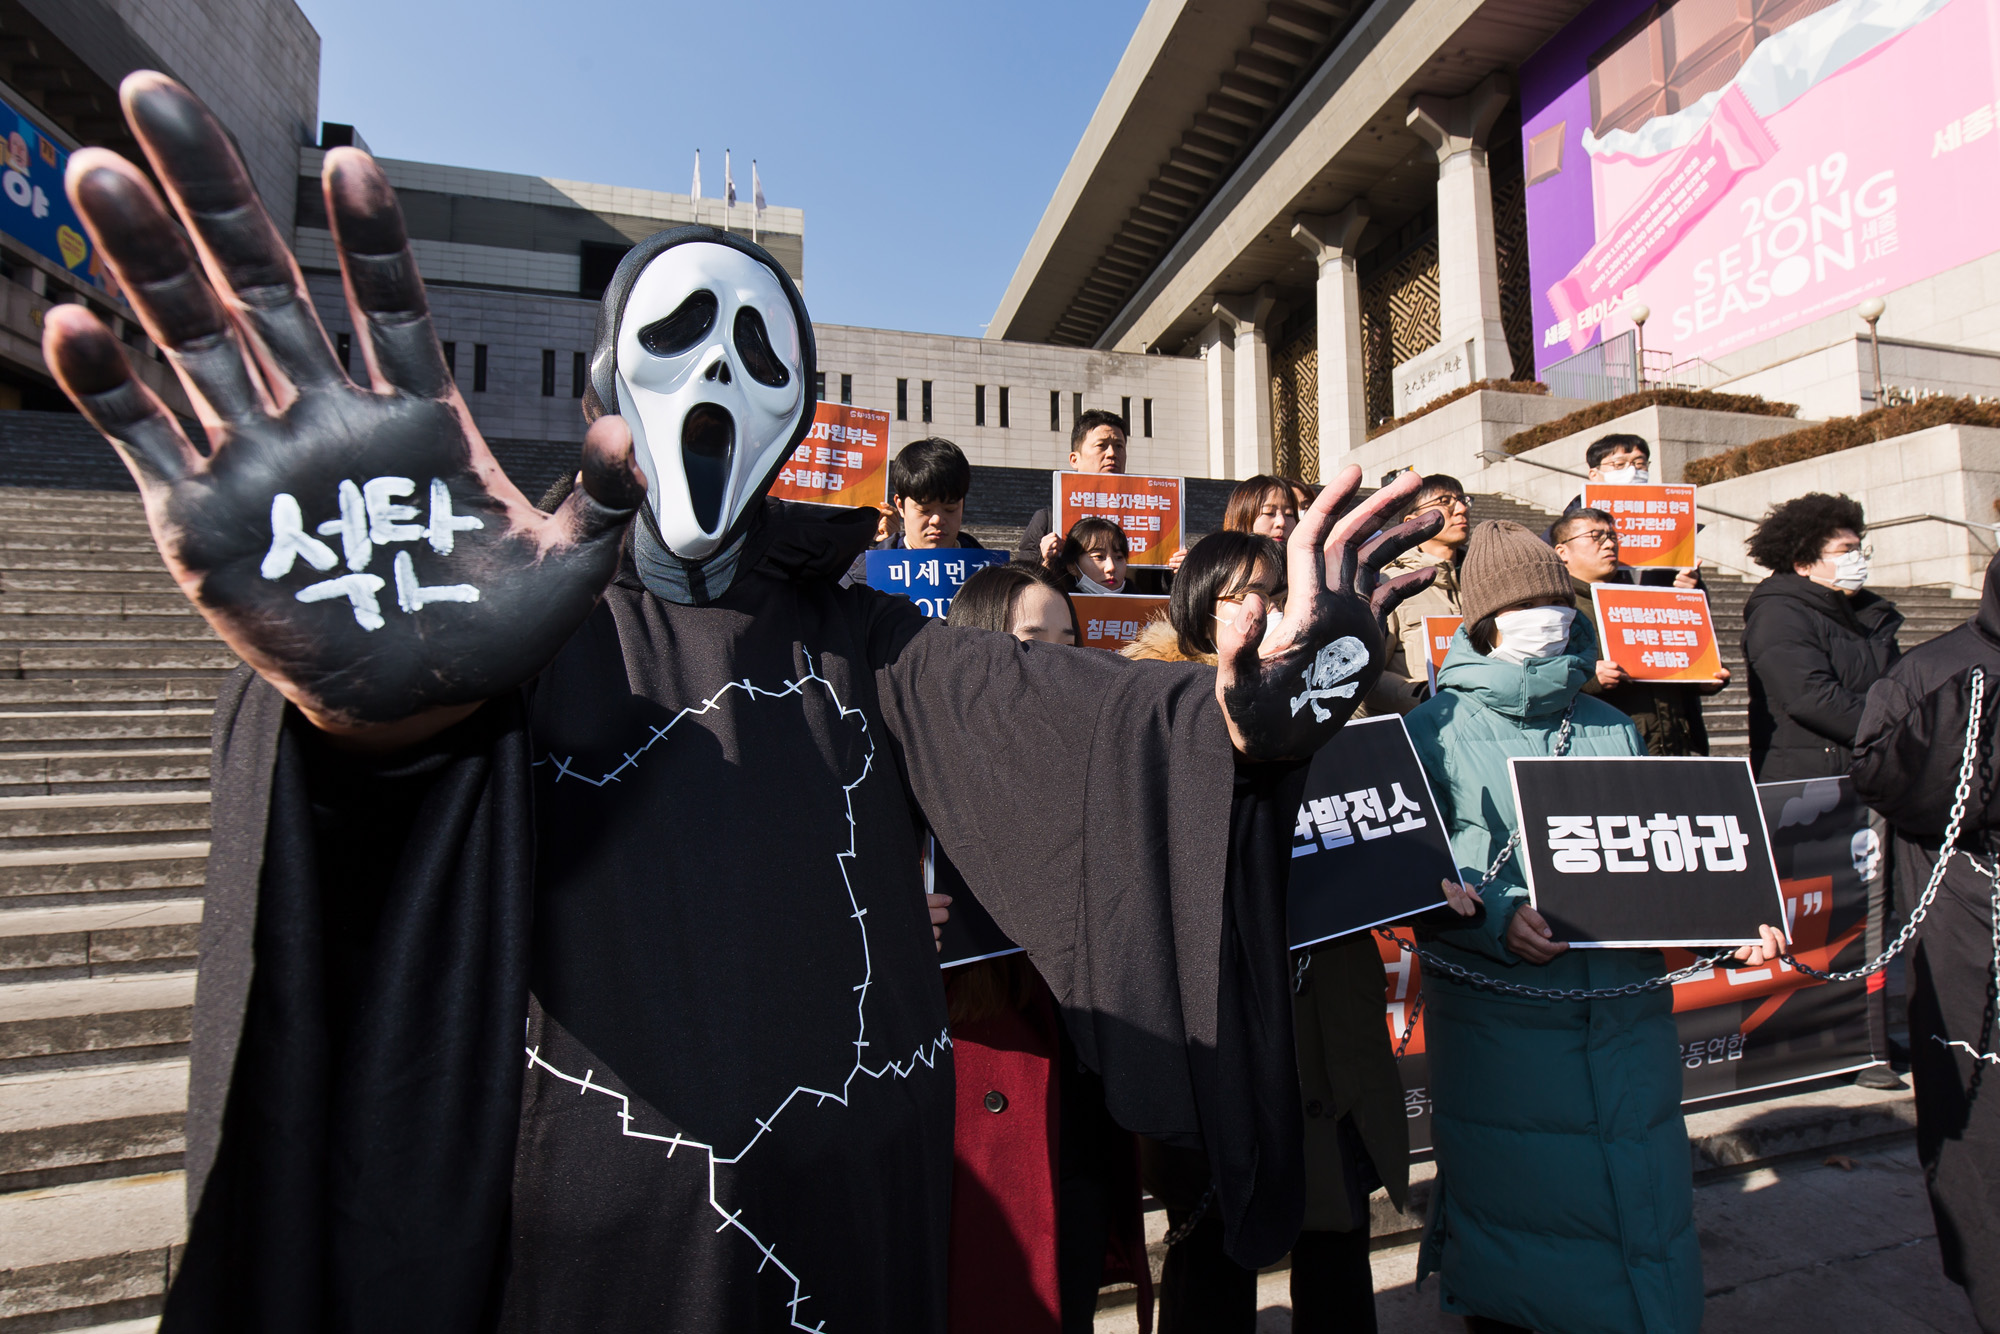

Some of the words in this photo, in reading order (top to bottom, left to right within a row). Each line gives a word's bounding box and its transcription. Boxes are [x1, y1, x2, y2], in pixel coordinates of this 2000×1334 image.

[1931, 103, 2000, 159] 세종
[1740, 151, 1848, 238] 2019
[1692, 169, 1898, 297] SEJONG
[1861, 209, 1897, 243] 세종
[1862, 231, 1899, 264] 시즌
[1672, 229, 1856, 342] SEASON
[1543, 318, 1572, 349] 세종
[1577, 284, 1641, 331] 테이스트
[815, 447, 863, 469] 로드맵
[779, 467, 845, 491] 수립하라
[1069, 491, 1171, 510] 산업통상자원부는
[1669, 501, 1690, 514] 한국
[1123, 515, 1161, 531] 로드맵
[1625, 517, 1677, 531] 지구온난화
[260, 475, 485, 633] 석탄
[1087, 618, 1138, 640] 침묵의
[1608, 606, 1703, 625] 산업통상자원부는
[1622, 628, 1660, 645] 탈석탄
[1661, 630, 1698, 646] 로드맵
[1641, 651, 1690, 668] 수립하라
[1546, 812, 1750, 874] 중단하라
[1680, 1032, 1748, 1069] 동연합
